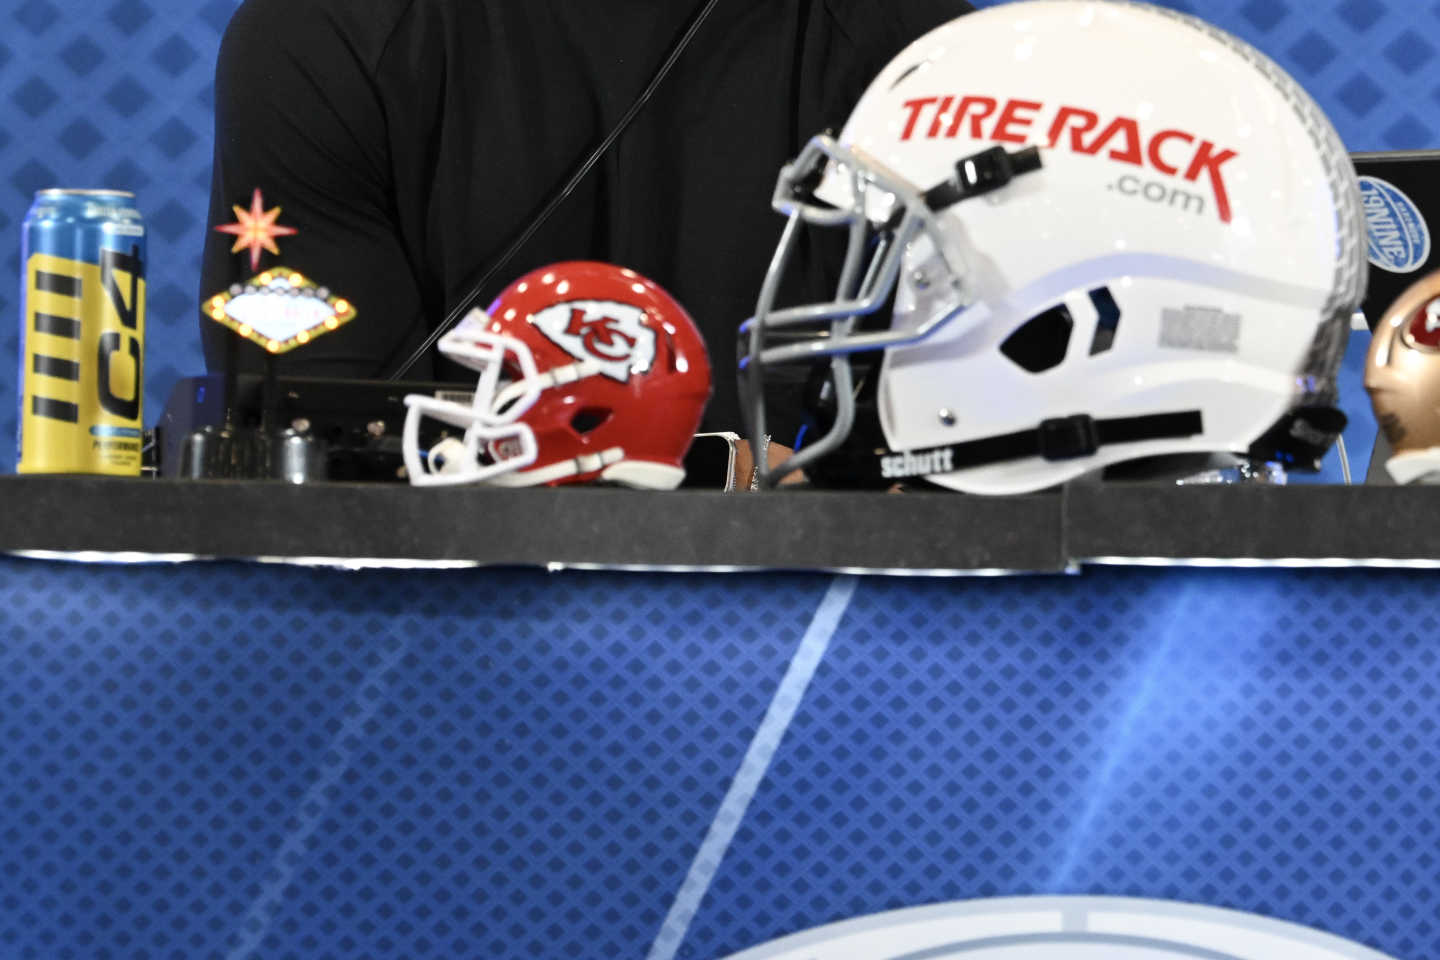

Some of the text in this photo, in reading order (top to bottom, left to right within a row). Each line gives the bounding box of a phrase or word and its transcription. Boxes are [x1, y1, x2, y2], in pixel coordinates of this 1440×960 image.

[900, 95, 1240, 224] TIRE RACK
[1107, 174, 1206, 216] .com
[97, 243, 147, 421] C4
[565, 307, 637, 363] KC
[881, 447, 954, 477] schutt
